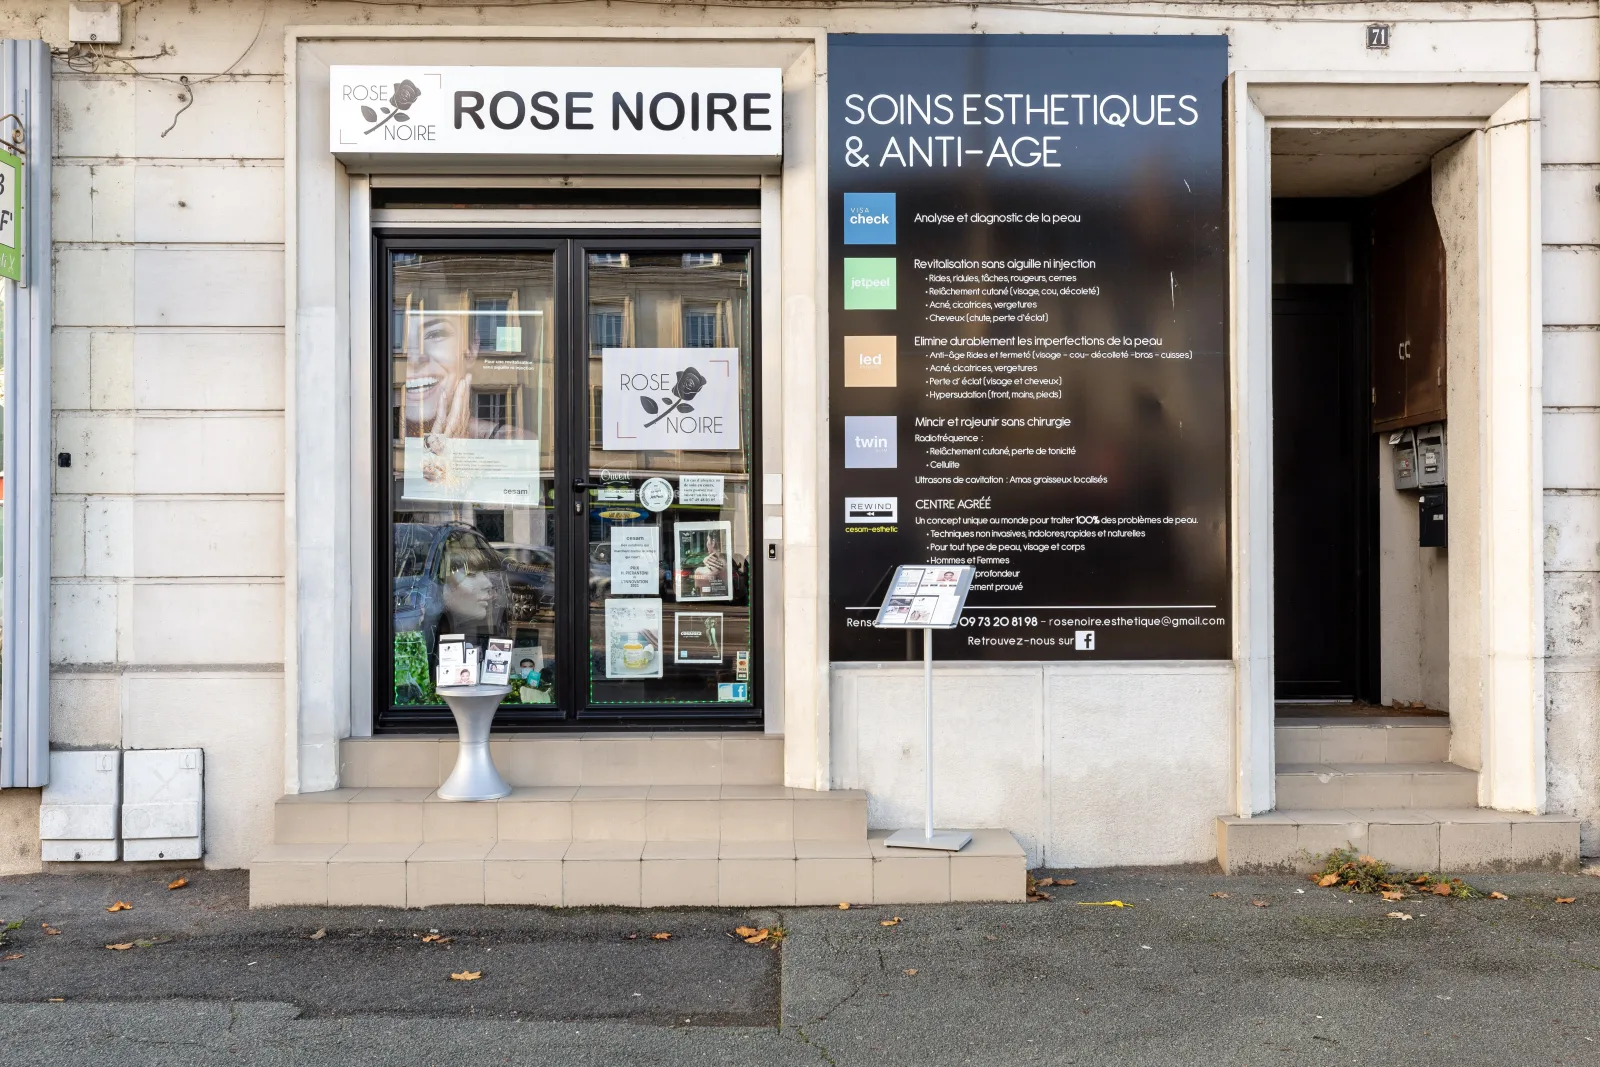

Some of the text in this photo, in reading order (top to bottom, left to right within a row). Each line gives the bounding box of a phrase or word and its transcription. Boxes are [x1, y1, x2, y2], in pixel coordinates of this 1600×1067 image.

[1373, 29, 1385, 44] 71
[343, 85, 387, 100] ROSE
[454, 91, 771, 131] ROSE NOIRE
[845, 94, 1198, 127] SOINS ESTHETIQUES
[385, 125, 435, 140] NOIRE
[845, 136, 1061, 167] & ANTI-AGE
[850, 214, 889, 224] check
[914, 213, 1080, 225] Analyse et diagnostic de la peau
[915, 259, 979, 268] Revitalisation
[1007, 259, 1041, 270] aiguille
[1044, 259, 1051, 268] ni
[1054, 259, 1095, 270] injection
[851, 278, 889, 289] jetpeel
[929, 274, 951, 283] Rides,
[953, 275, 980, 283] ridules,
[981, 274, 1009, 283] tâches,
[929, 287, 980, 295] Relâchement
[982, 287, 1008, 295] cutané
[1010, 287, 1040, 296] (visage,
[1060, 287, 1099, 295] décoleté)
[930, 300, 1037, 310] Acné, cicatrices, vergetures
[993, 315, 1015, 323] perte
[915, 336, 1162, 347] Elimine durablement les imperfections de la peau
[860, 354, 881, 365] led
[1033, 351, 1061, 360] (visage
[1161, 351, 1192, 359] cuisses)
[930, 364, 1037, 373] Acné, cicatrices, vergetures
[621, 374, 669, 390] ROSE
[962, 377, 982, 385] éclat
[983, 377, 1012, 386] (visage
[1024, 376, 1061, 385] cheveux)
[930, 391, 986, 400] Hypersudation
[1012, 391, 1035, 399] mains,
[1036, 390, 1061, 399] pieds)
[667, 417, 722, 433] NOIRE
[915, 417, 945, 426] Mincir
[948, 417, 959, 426] et
[961, 417, 999, 428] rajeunir
[1027, 417, 1071, 428] chirurgie
[855, 436, 887, 447] twin
[915, 434, 978, 443] Radiofréquence
[930, 447, 981, 455] Relâchement
[983, 447, 1010, 456] cutané,
[1012, 448, 1034, 456] perte
[1033, 476, 1071, 485] graisseux
[1074, 475, 1107, 483] localisés
[916, 496, 991, 509] CENTRE AGRÉÉ
[927, 517, 961, 525] concept
[963, 517, 988, 525] unique
[1076, 516, 1100, 524] 100%
[1118, 516, 1161, 525] problèmes
[931, 530, 974, 539] Techniques
[992, 530, 1027, 538] invasives,
[931, 543, 948, 551] Pour
[967, 544, 984, 552] type
[1023, 543, 1049, 552] visage
[977, 556, 1009, 564] Femmes
[974, 568, 1020, 578] profondeur
[995, 582, 1023, 592] prouvé
[958, 616, 975, 626] 09
[978, 617, 990, 626] 73
[993, 617, 1009, 626] 20
[1050, 616, 1224, 627] rosenoire.esthetique@gmail.com
[968, 637, 1055, 645] Retrouvez-nous
